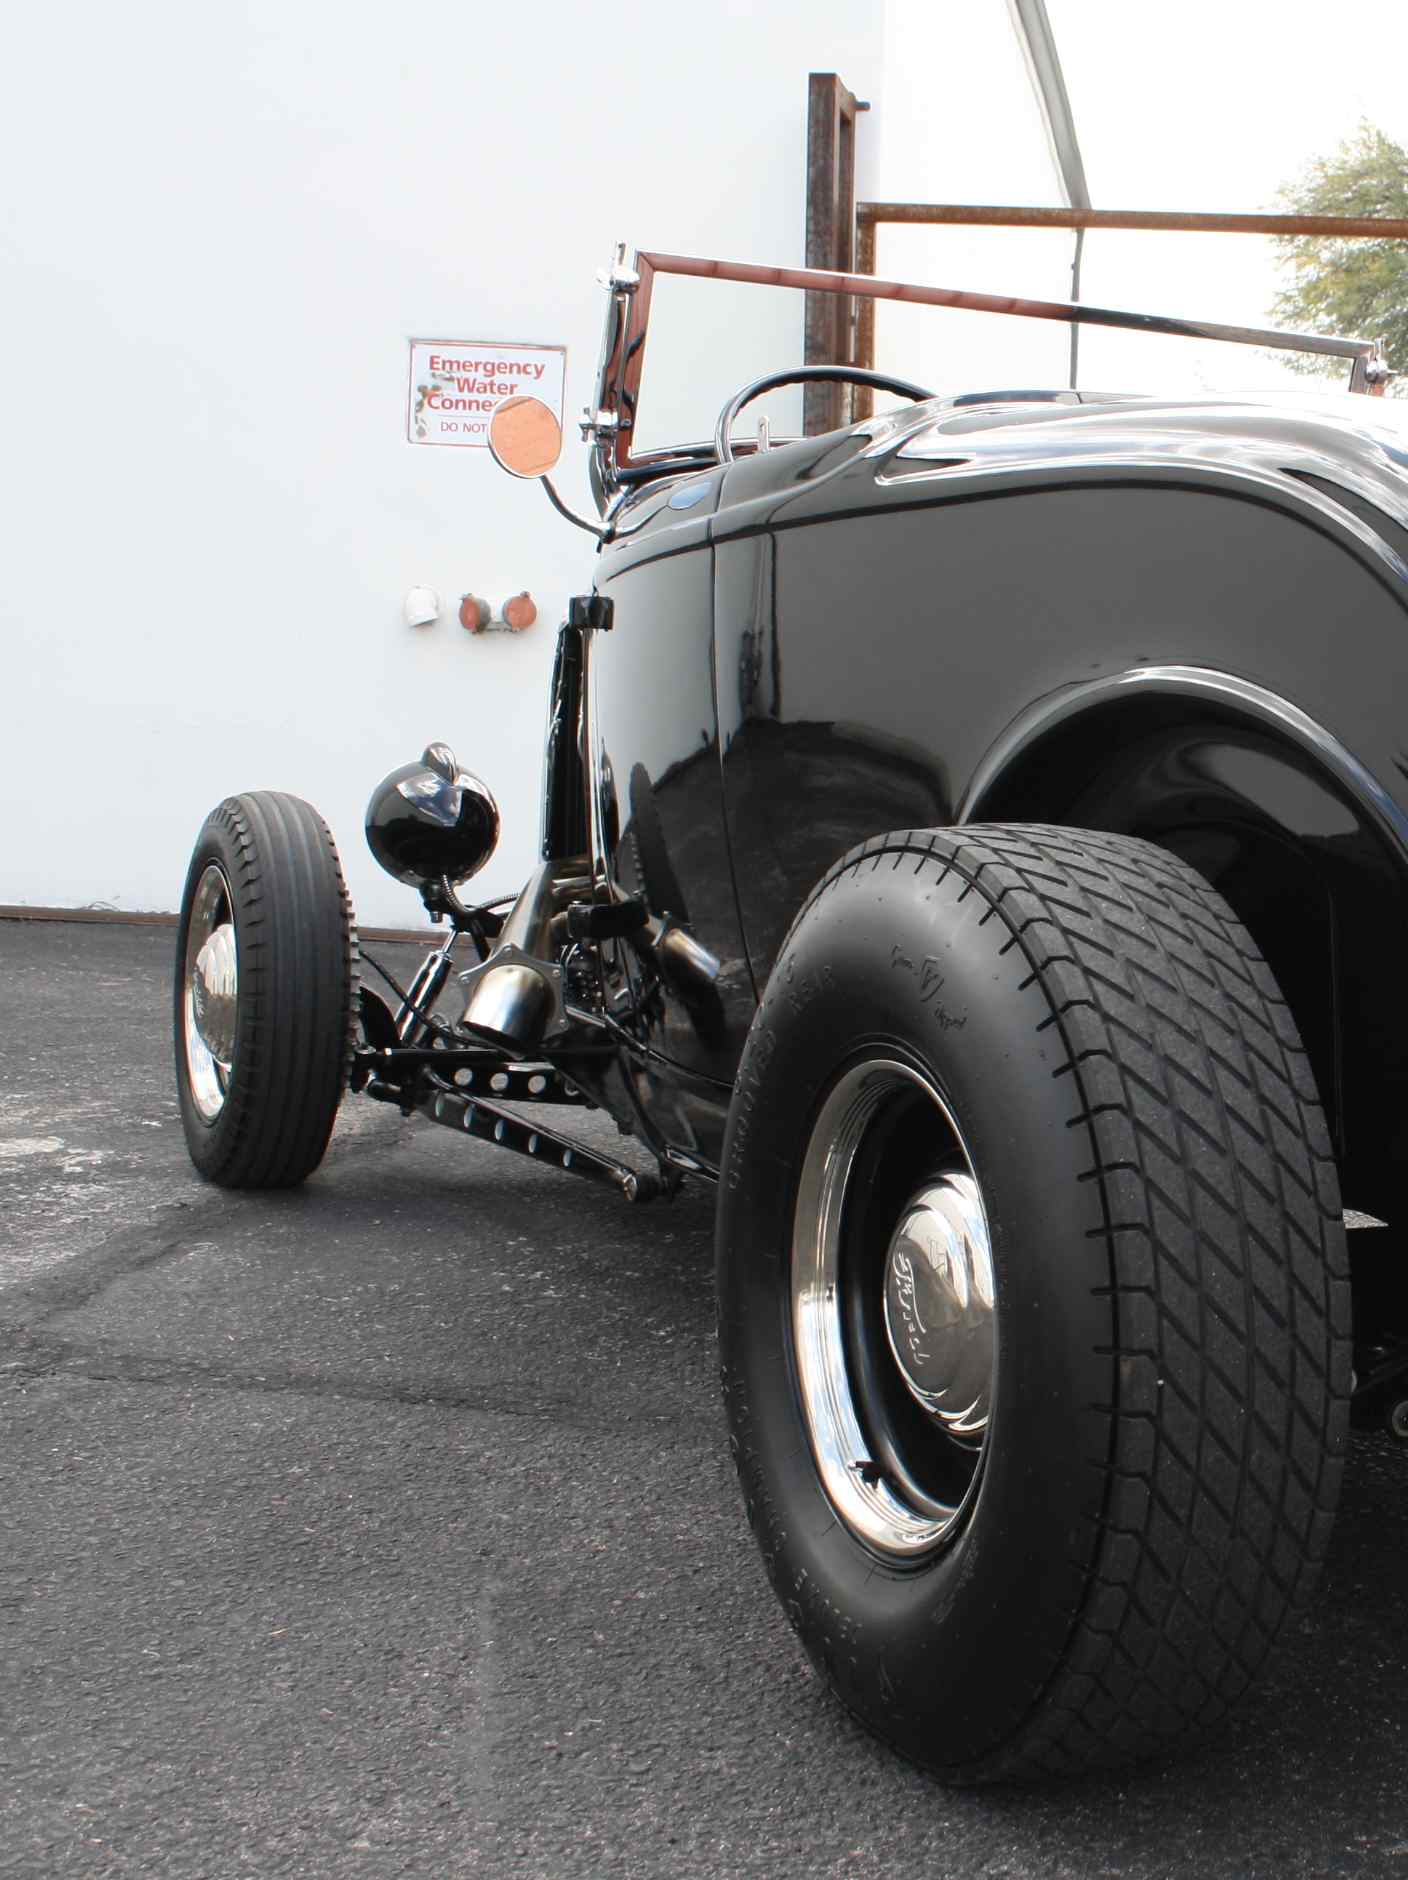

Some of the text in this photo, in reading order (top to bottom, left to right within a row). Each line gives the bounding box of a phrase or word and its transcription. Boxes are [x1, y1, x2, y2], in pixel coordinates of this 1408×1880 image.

[429, 355, 545, 380] Emergency
[455, 377, 518, 396] Water
[427, 393, 499, 412] Conne
[440, 421, 487, 433] DO NOT
